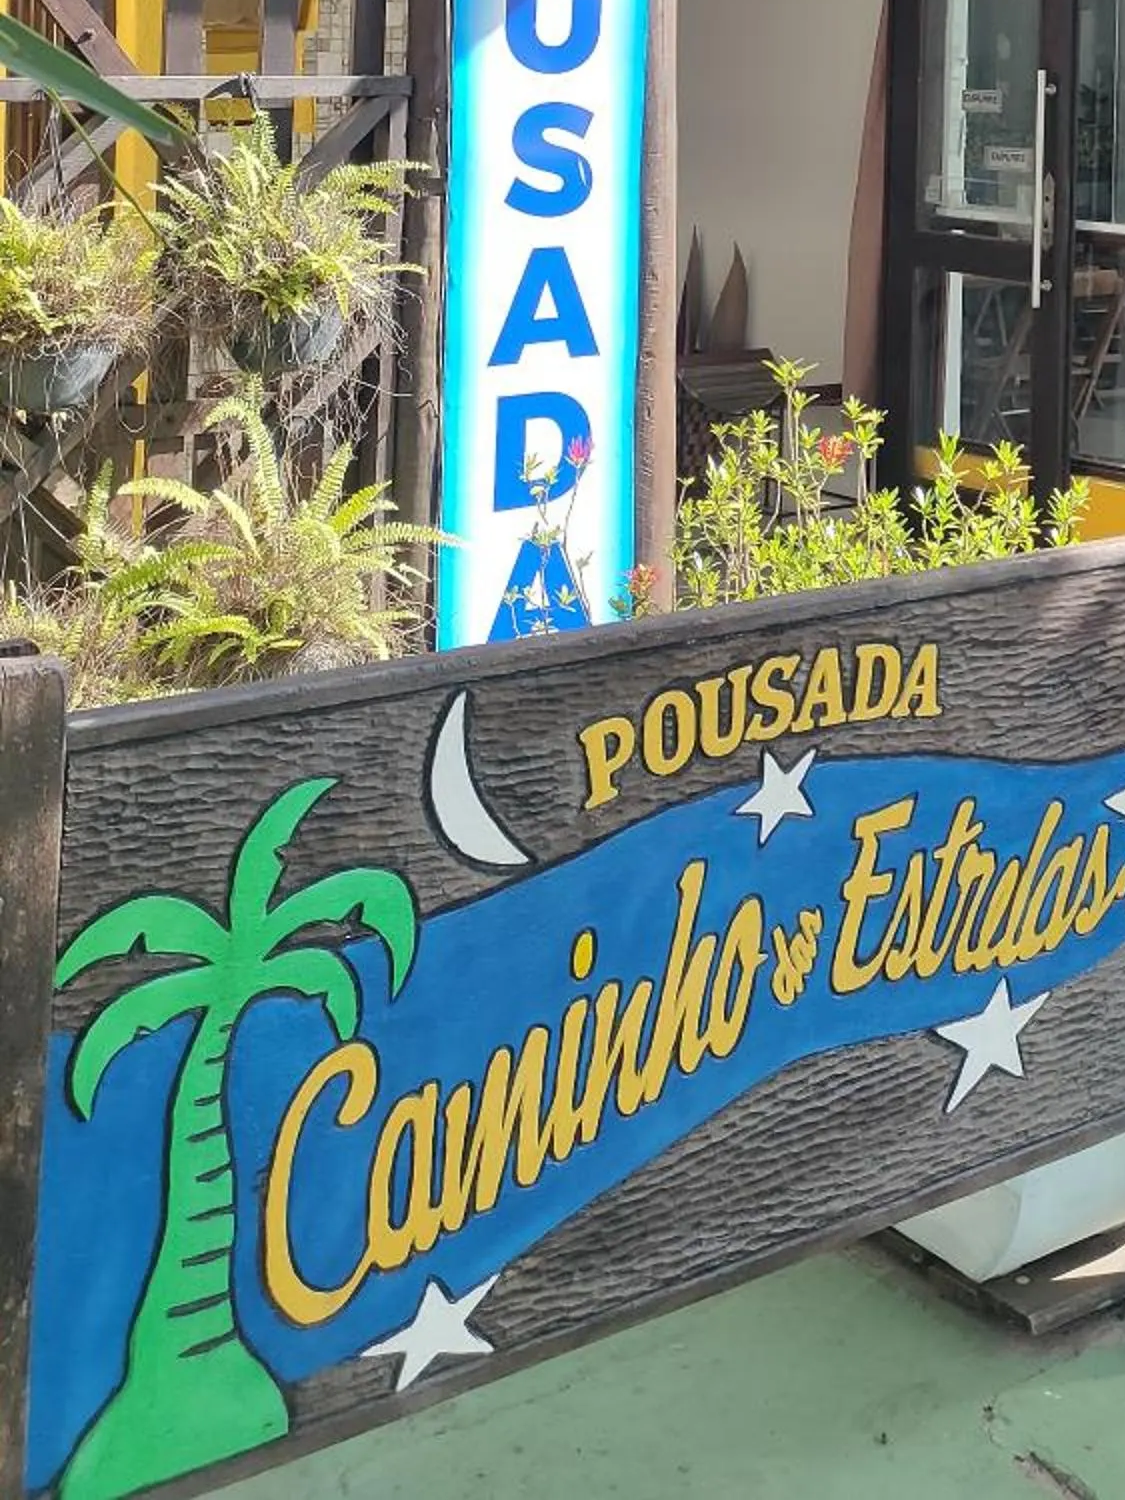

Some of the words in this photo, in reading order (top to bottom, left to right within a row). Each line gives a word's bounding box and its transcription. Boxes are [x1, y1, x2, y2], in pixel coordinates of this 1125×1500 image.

[578, 642, 943, 812] POUSADA
[264, 859, 766, 1328] Caminho
[771, 906, 823, 1006] das
